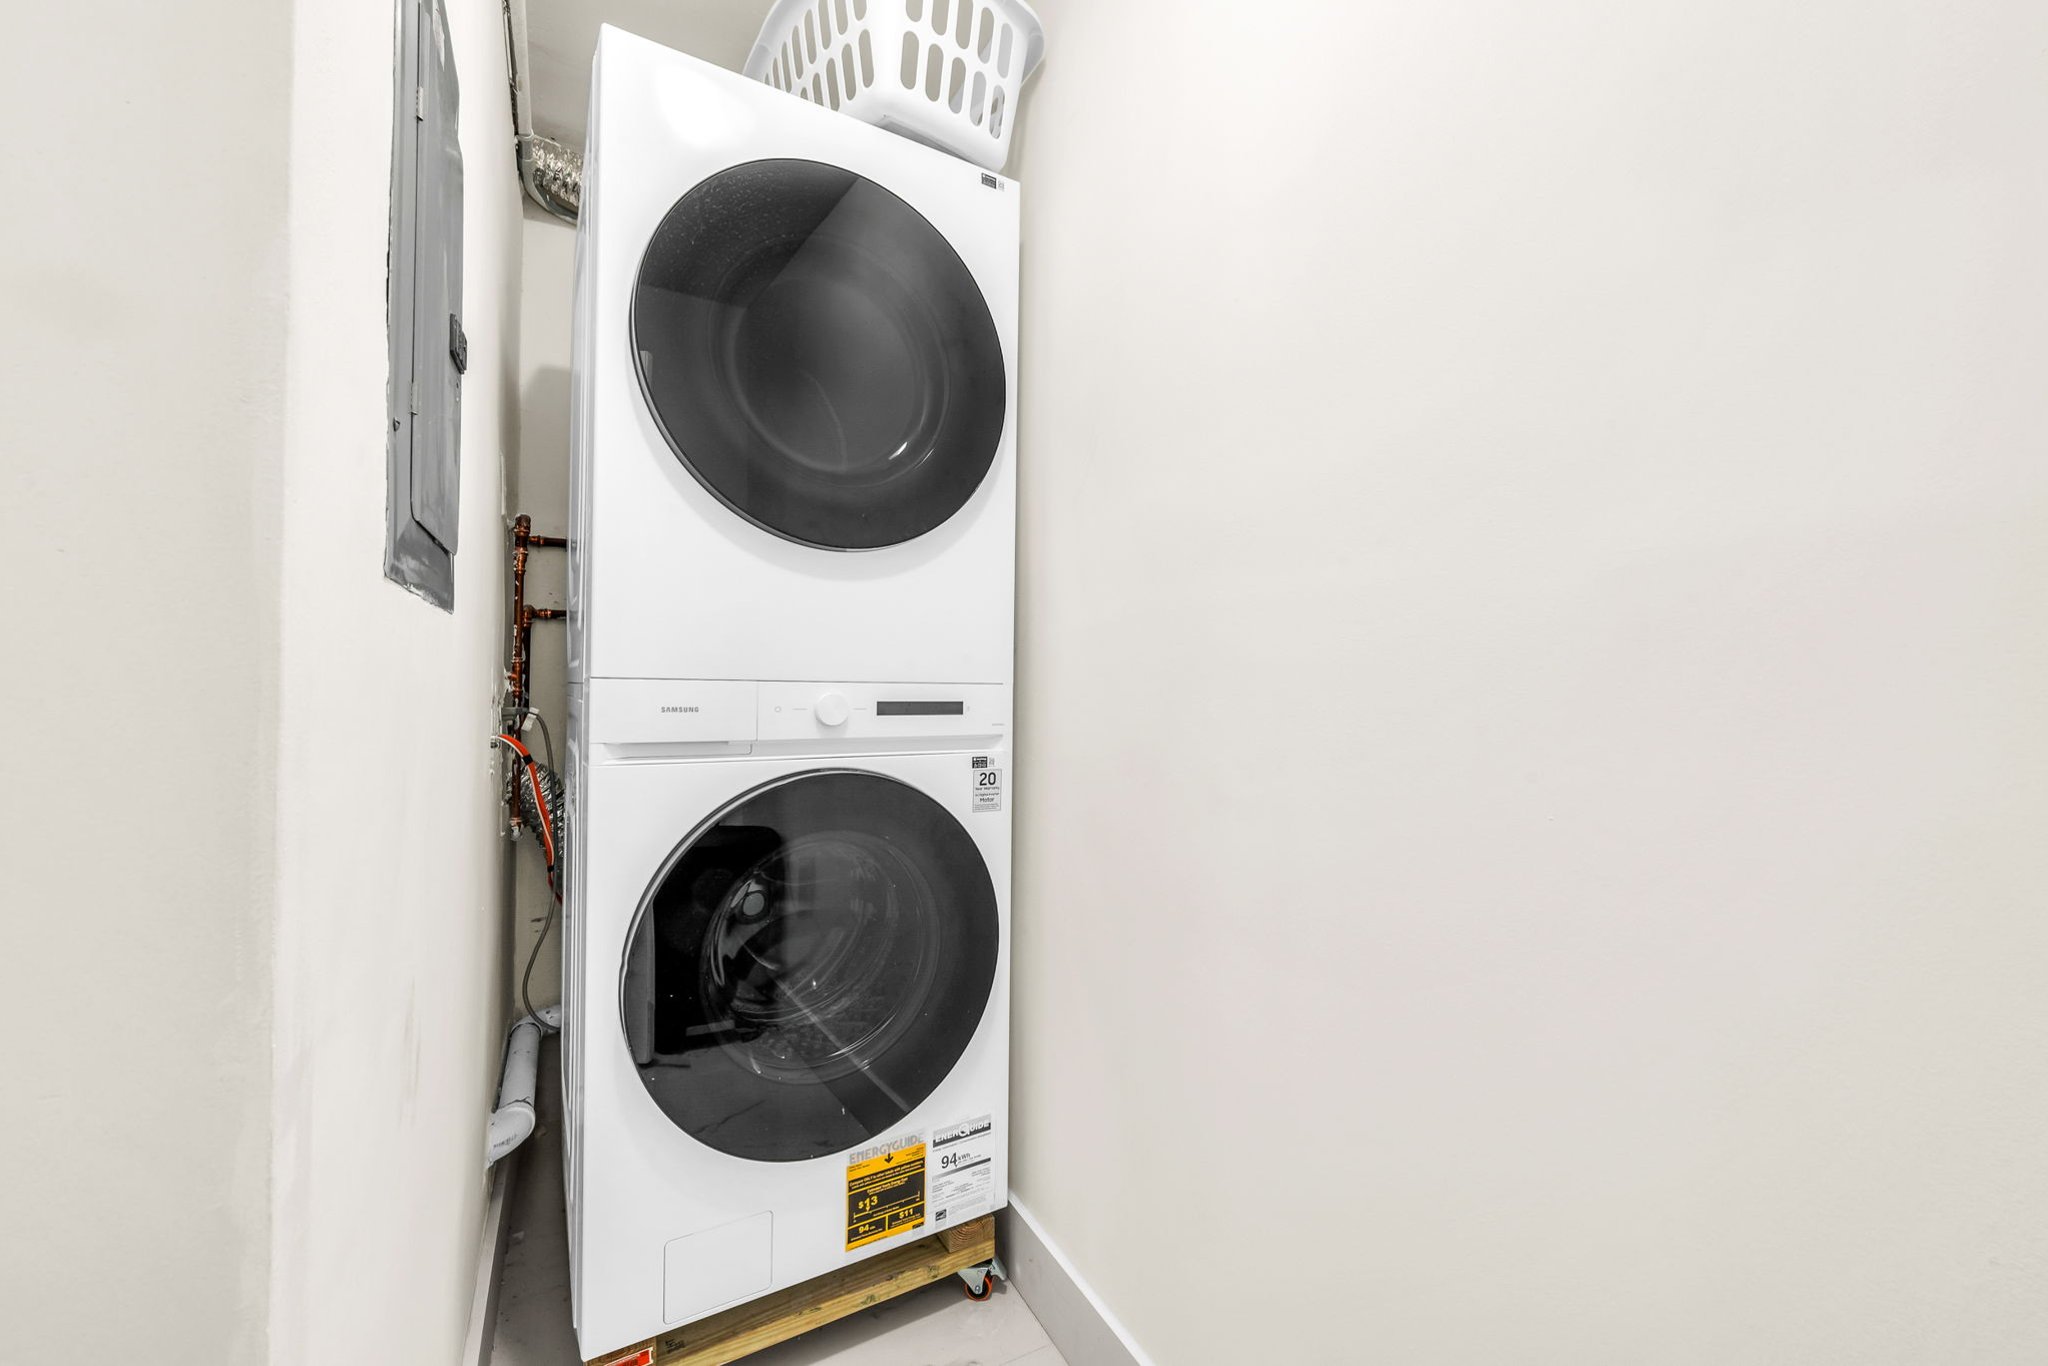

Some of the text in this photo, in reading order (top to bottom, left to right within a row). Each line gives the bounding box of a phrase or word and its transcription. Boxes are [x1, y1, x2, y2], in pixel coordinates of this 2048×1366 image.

[660, 706, 700, 714] SAMSUNG
[979, 772, 997, 786] 20
[849, 1132, 925, 1164] ENERGYGUIDE
[941, 1151, 958, 1169] 94
[858, 1195, 878, 1209] $13
